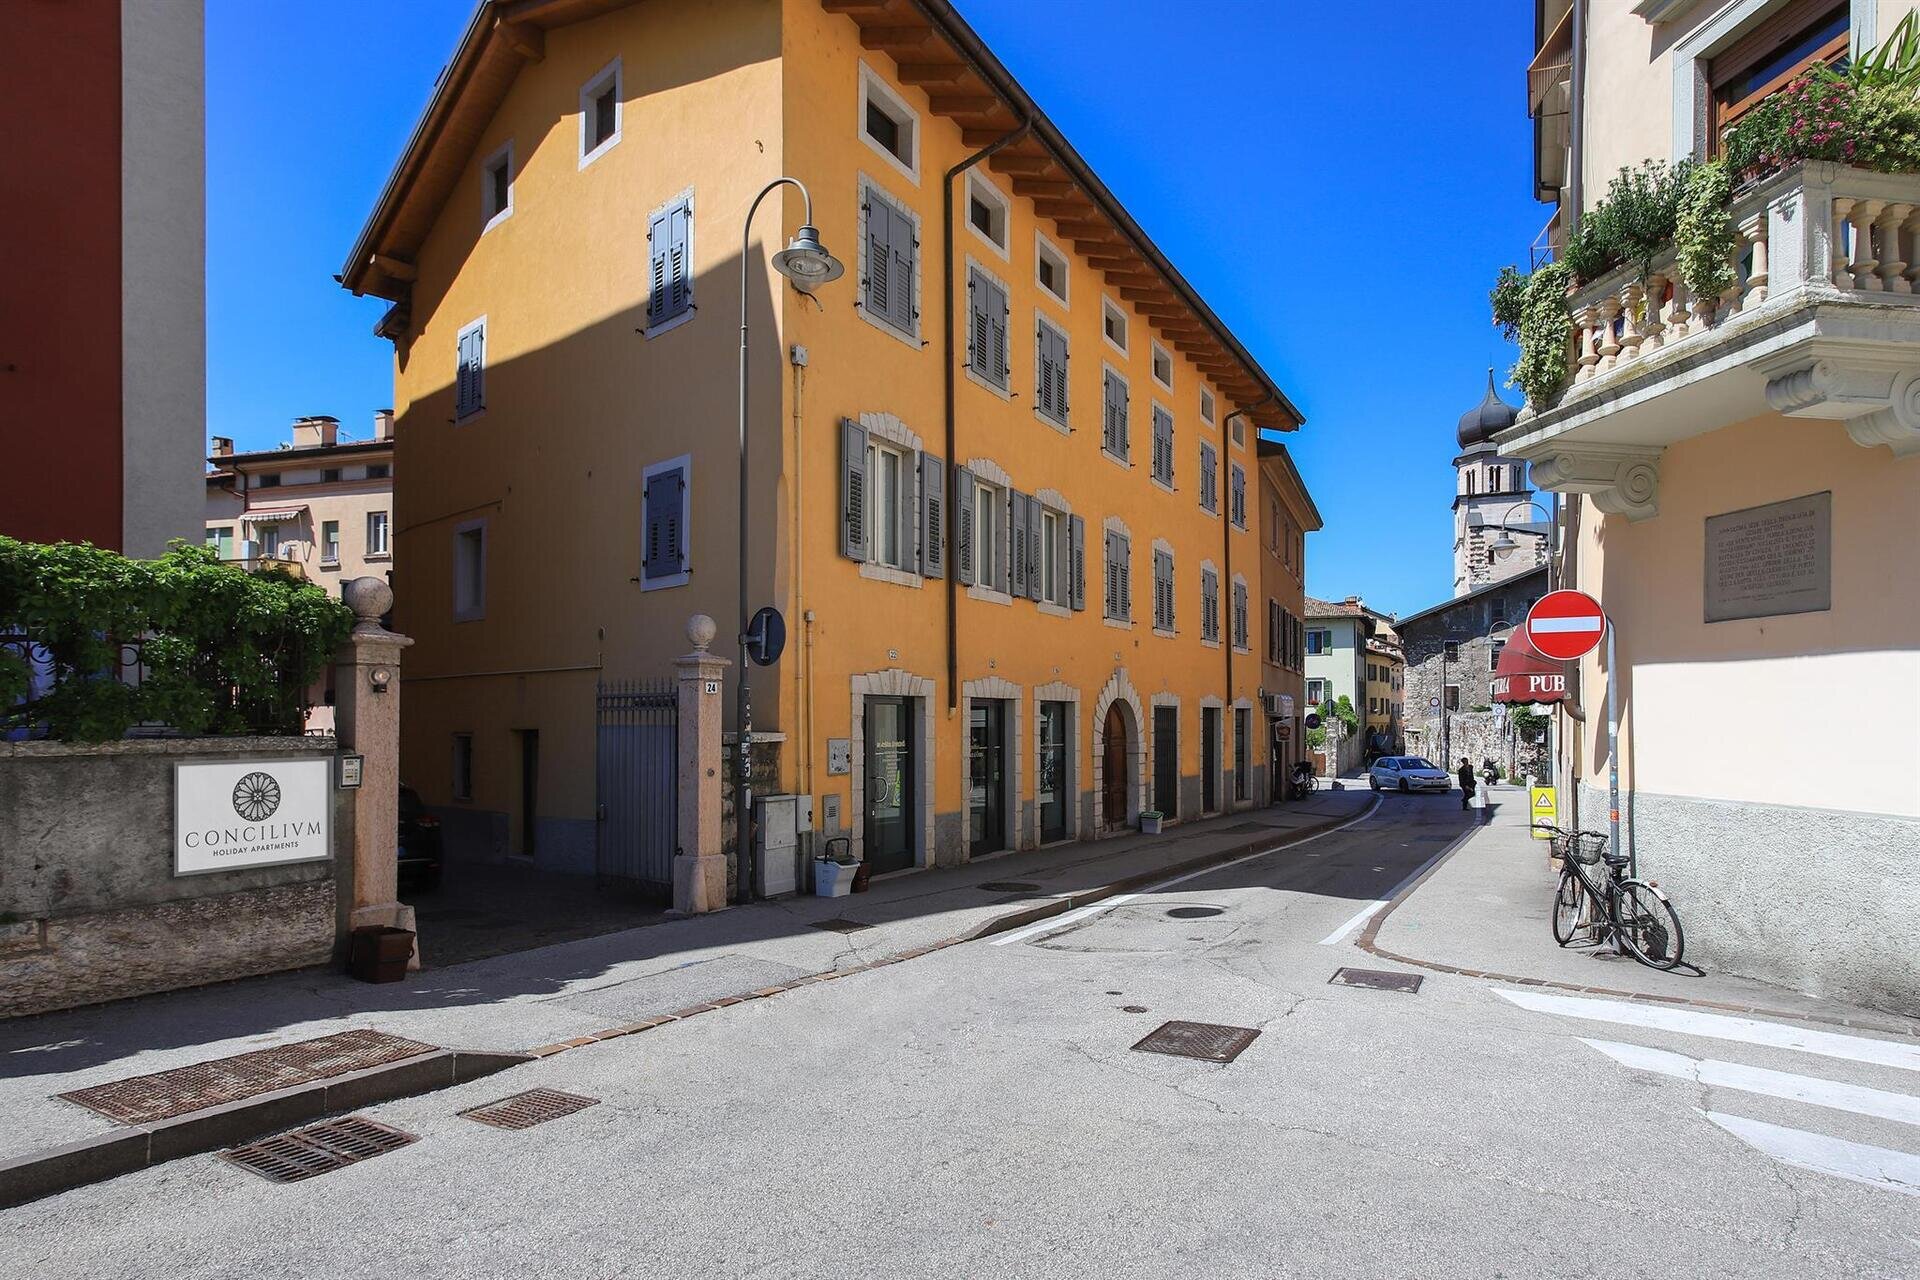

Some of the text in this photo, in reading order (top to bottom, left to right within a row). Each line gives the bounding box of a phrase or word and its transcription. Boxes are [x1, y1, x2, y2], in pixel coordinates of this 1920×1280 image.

[707, 683, 716, 692] 24
[1528, 674, 1565, 693] PUB
[185, 821, 321, 848] CONCILIVM
[213, 841, 299, 857] HOLIDAY APARTMENTS
